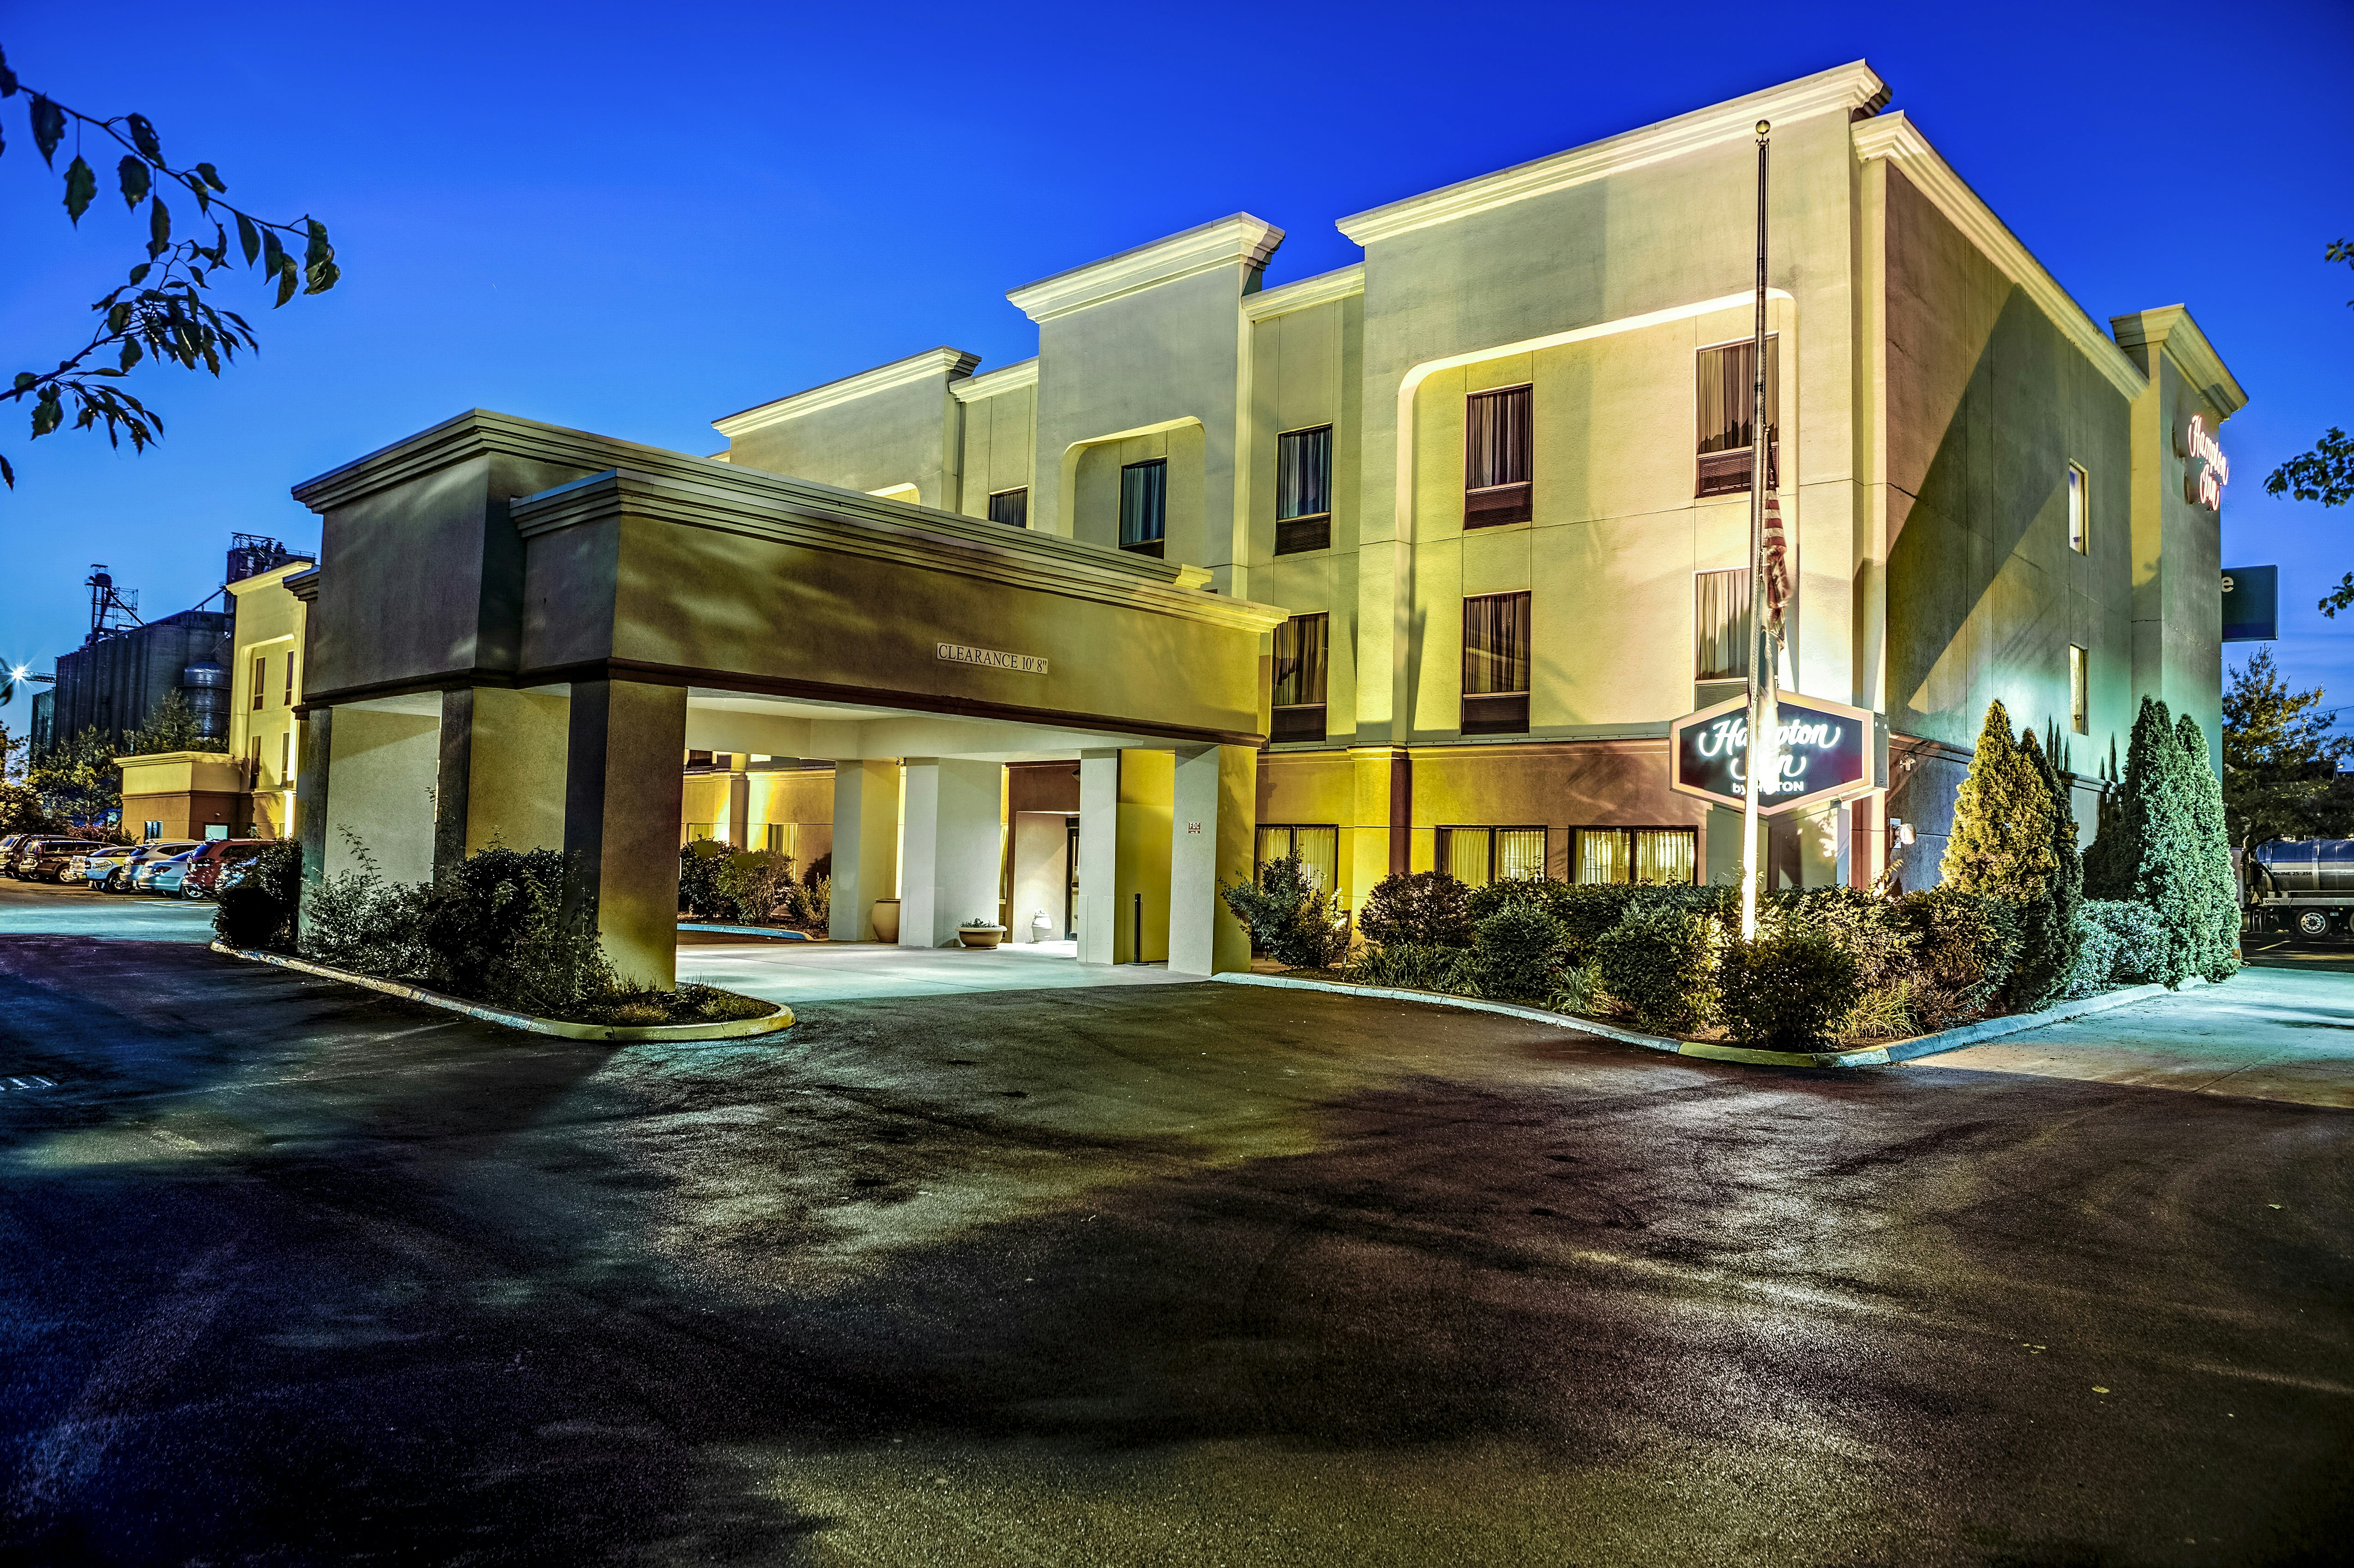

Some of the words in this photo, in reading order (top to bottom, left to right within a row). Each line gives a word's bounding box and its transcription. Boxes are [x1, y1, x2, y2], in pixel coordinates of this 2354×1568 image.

[2188, 415, 2229, 485] Hampton
[2199, 463, 2220, 511] Inn
[938, 644, 1018, 668] CLEARANCE
[1022, 656, 1034, 671] 10'
[1699, 718, 1841, 757] Hapton
[1758, 781, 1804, 794] HTON
